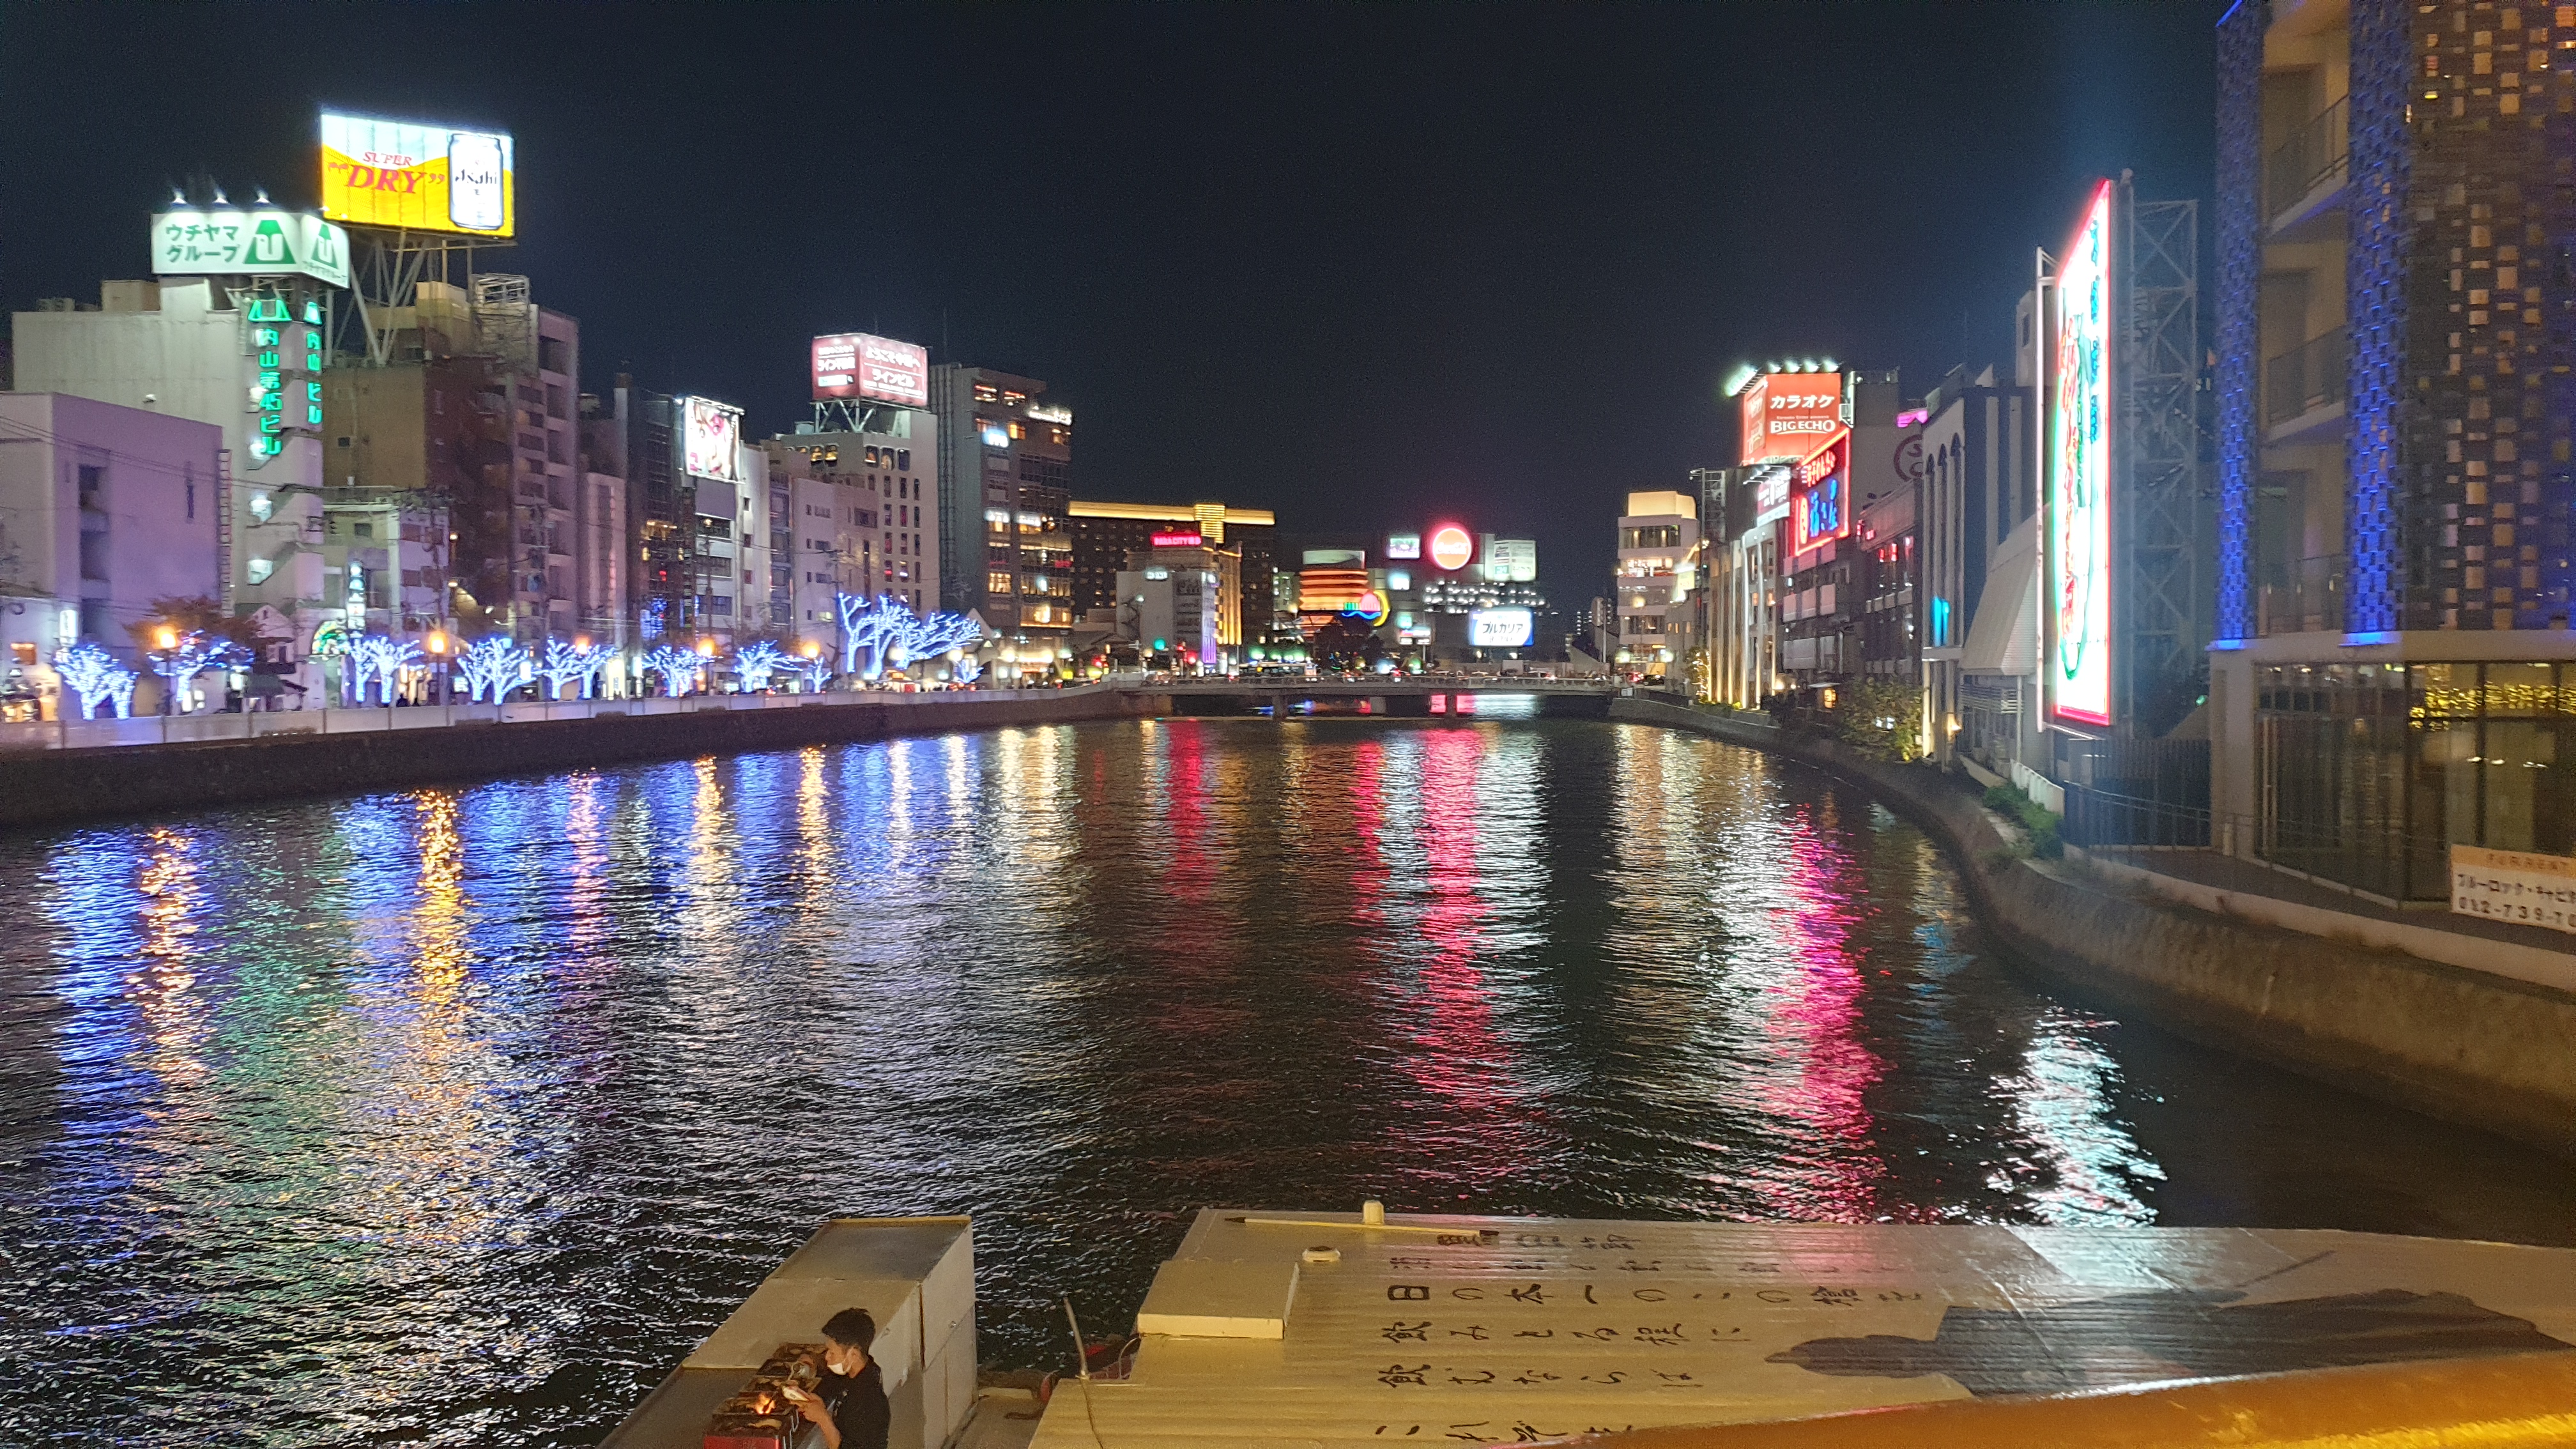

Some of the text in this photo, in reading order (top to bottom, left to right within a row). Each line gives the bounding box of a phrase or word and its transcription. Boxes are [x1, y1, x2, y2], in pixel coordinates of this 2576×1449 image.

[165, 224, 240, 242] ウチヤマ
[165, 243, 241, 263] グループ
[307, 331, 323, 425] 内山ビル
[1770, 394, 1836, 410] カラオケ
[1770, 419, 1836, 434] BIG ECHO
[1380, 1321, 1752, 1346] 飲みとる程に
[1377, 1363, 1705, 1389] 飲むならば
